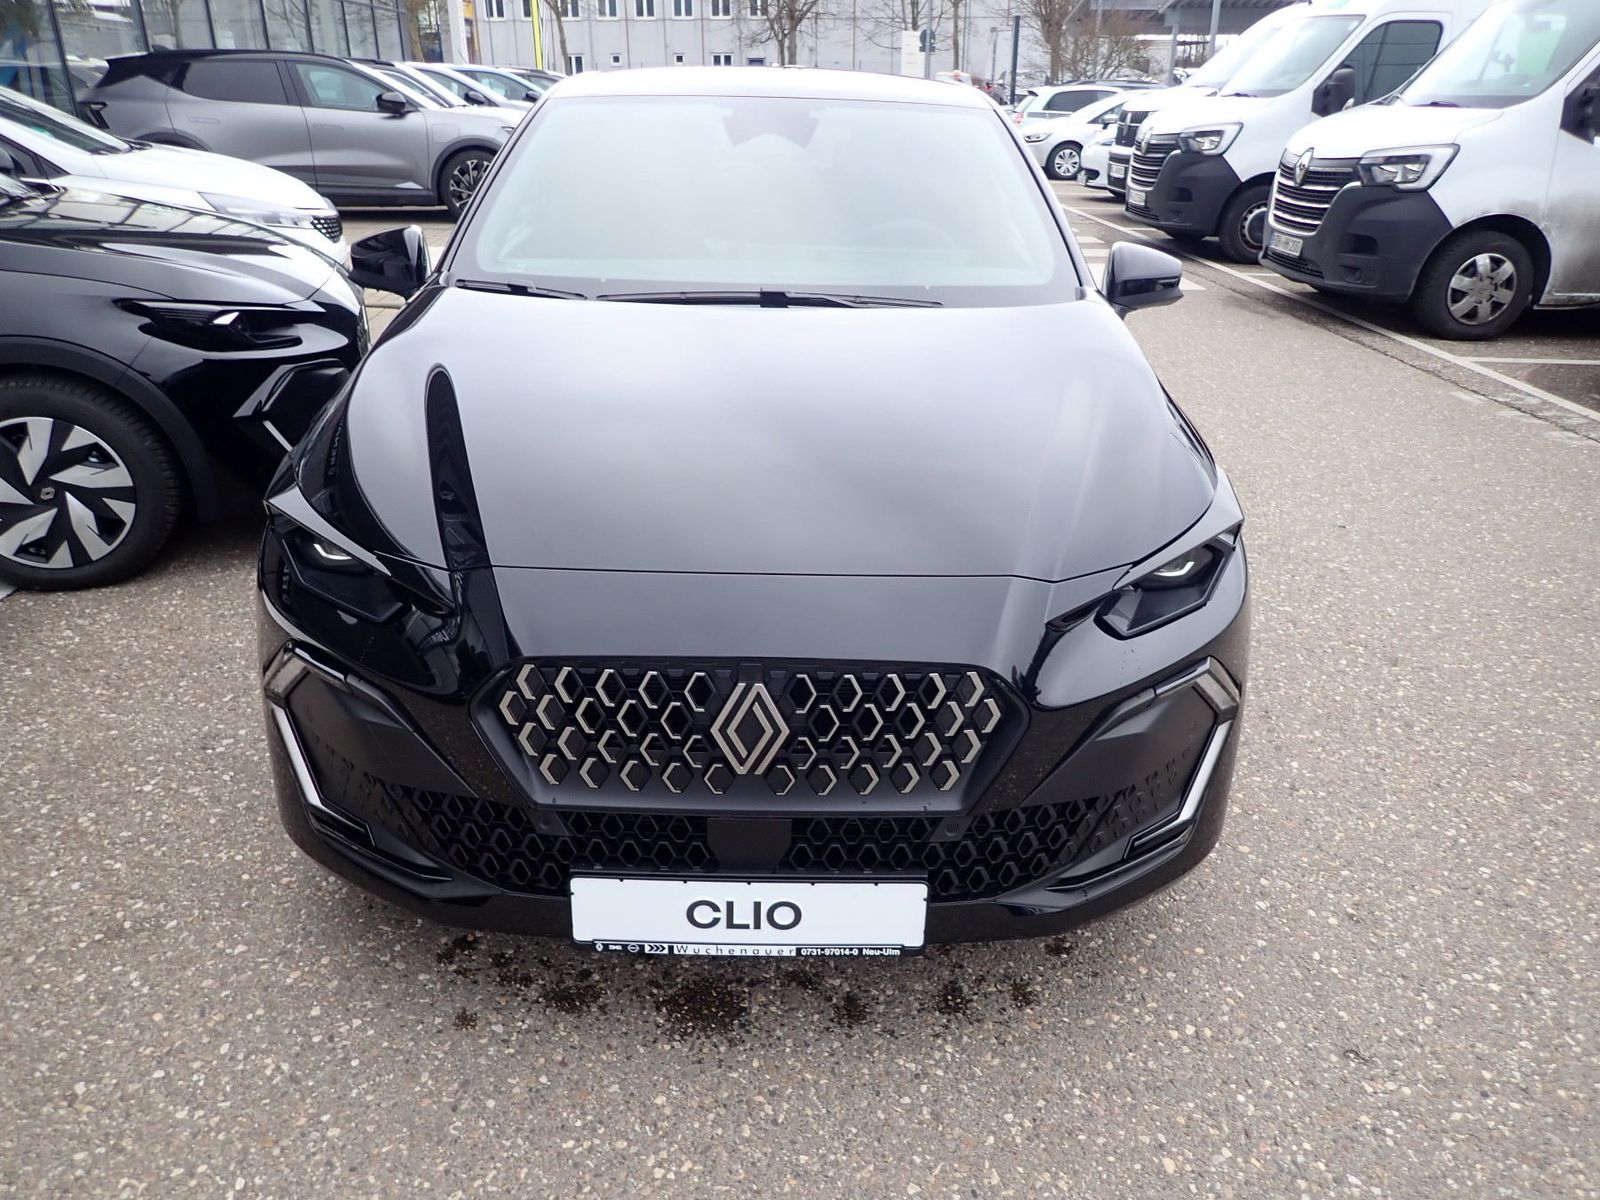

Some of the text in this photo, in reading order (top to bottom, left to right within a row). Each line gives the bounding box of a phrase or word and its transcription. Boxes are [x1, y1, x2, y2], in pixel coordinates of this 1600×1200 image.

[686, 899, 802, 930] CLIO
[675, 944, 795, 956] Wuchenauer
[862, 948, 901, 956] Neu-Ulm
